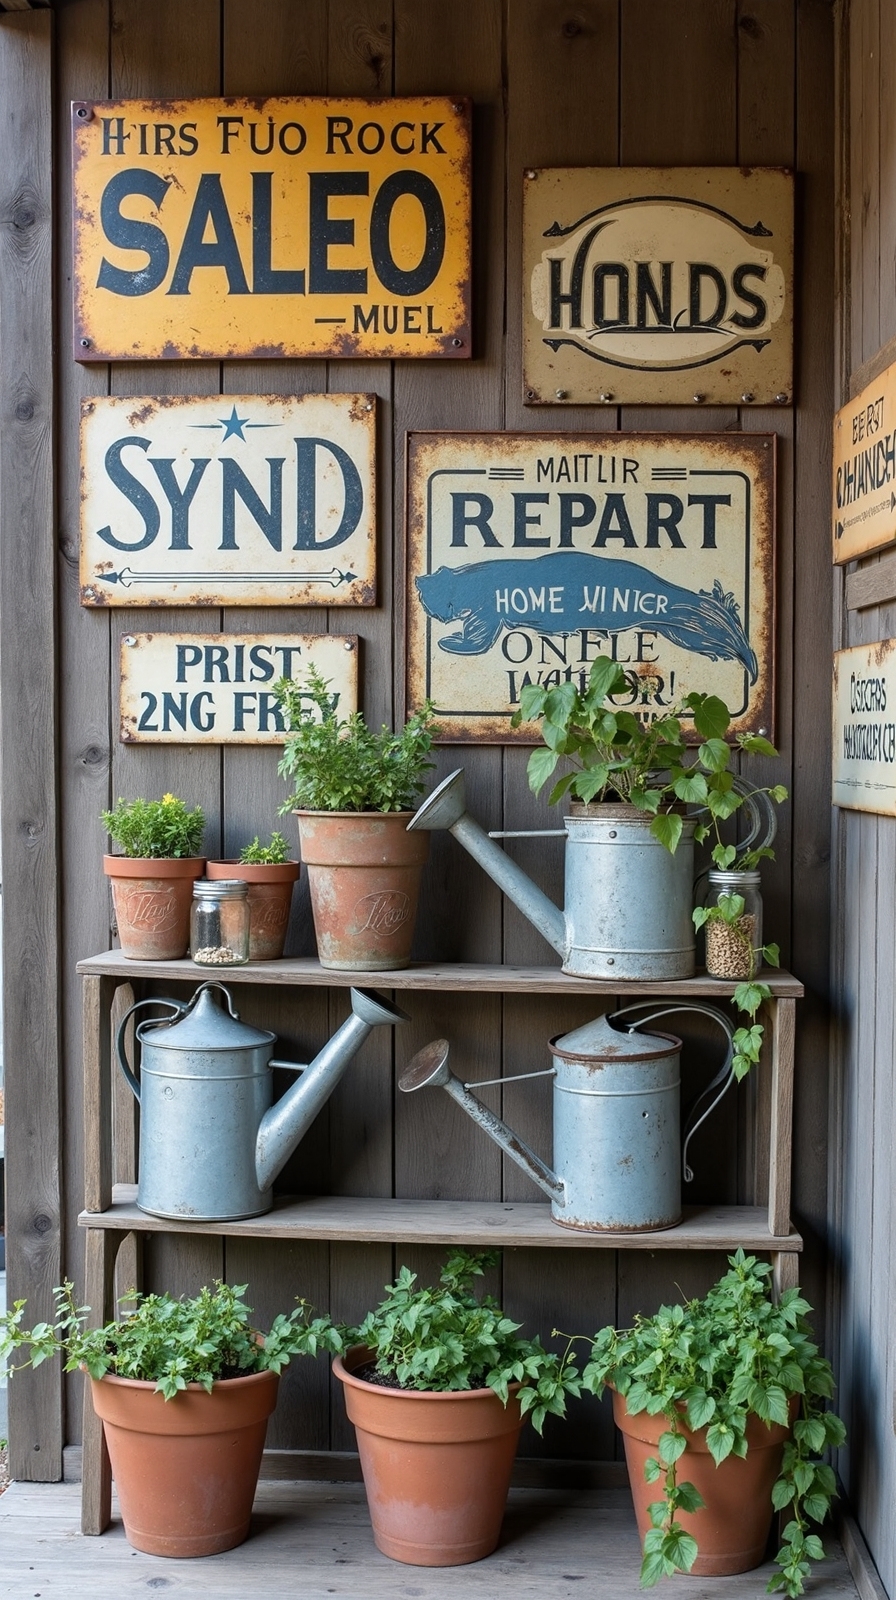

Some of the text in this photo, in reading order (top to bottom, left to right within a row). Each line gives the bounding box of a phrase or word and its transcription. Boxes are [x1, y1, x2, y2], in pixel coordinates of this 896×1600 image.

[216, 115, 308, 155] FUO
[325, 116, 447, 155] ROCK
[95, 167, 447, 296] SALEO
[547, 218, 768, 331] HONDS
[96, 435, 364, 552] SYND
[449, 491, 732, 549] REPART
[495, 586, 565, 615] HOME
[175, 644, 302, 684] PRIST
[137, 691, 217, 732] 2NG
